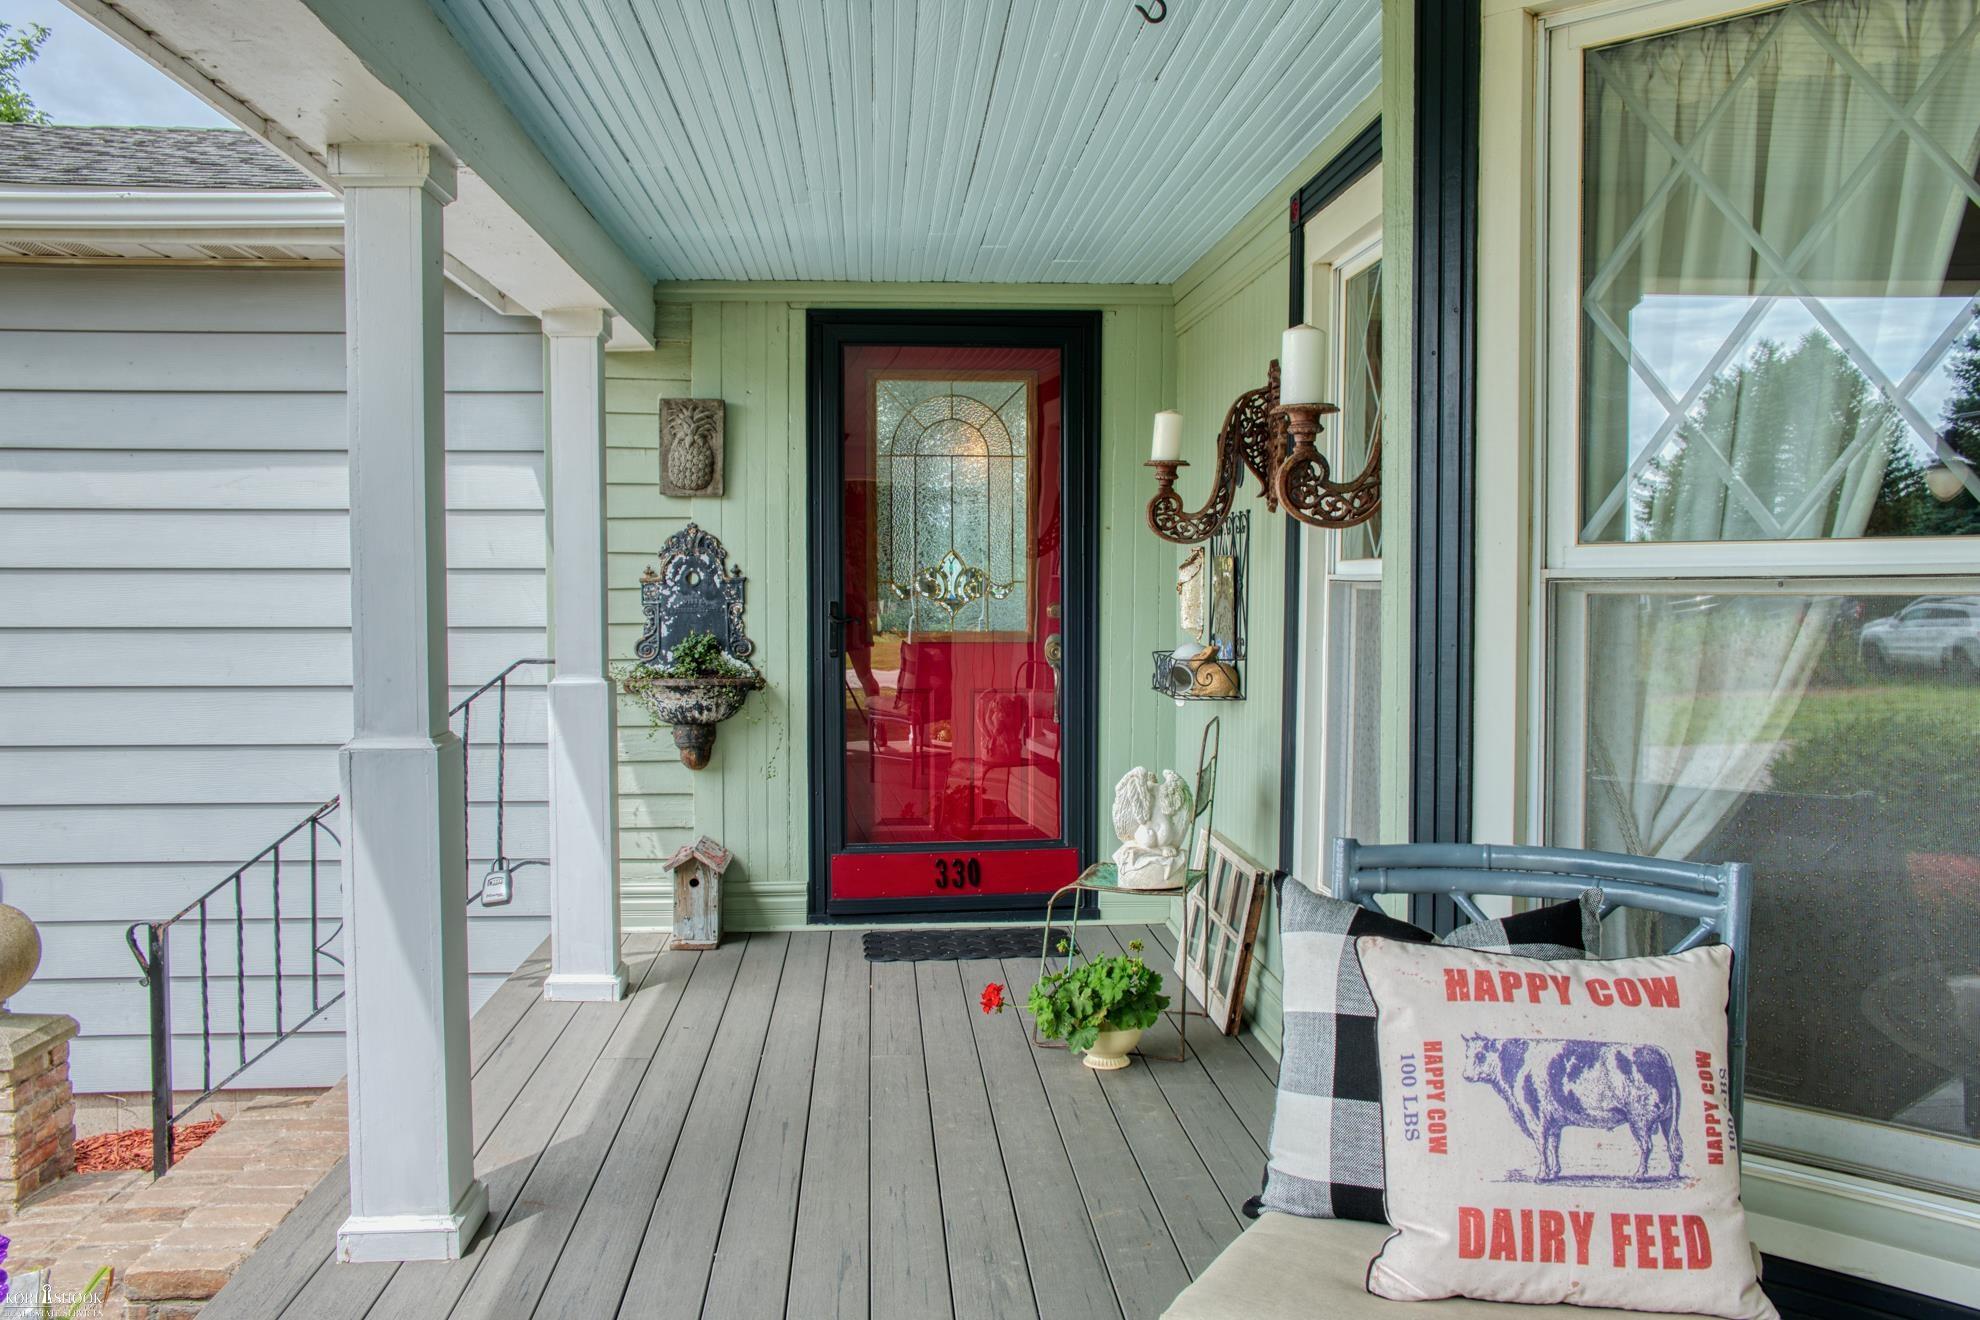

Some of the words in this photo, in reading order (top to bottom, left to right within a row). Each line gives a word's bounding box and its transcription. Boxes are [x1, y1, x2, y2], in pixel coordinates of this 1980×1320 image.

[935, 858, 981, 888] 330
[1443, 967, 1571, 1006] HAPPY
[1584, 975, 1681, 1009] COW
[1400, 1053, 1416, 1087] 100
[1423, 1041, 1446, 1102] HAPPY
[1695, 1050, 1715, 1095] COW
[1402, 1094, 1420, 1141] LBS
[1427, 1108, 1448, 1155] COW
[1703, 1100, 1724, 1165] HAPPY
[1458, 1206, 1595, 1266] DAIRY
[1610, 1212, 1713, 1271] FEED
